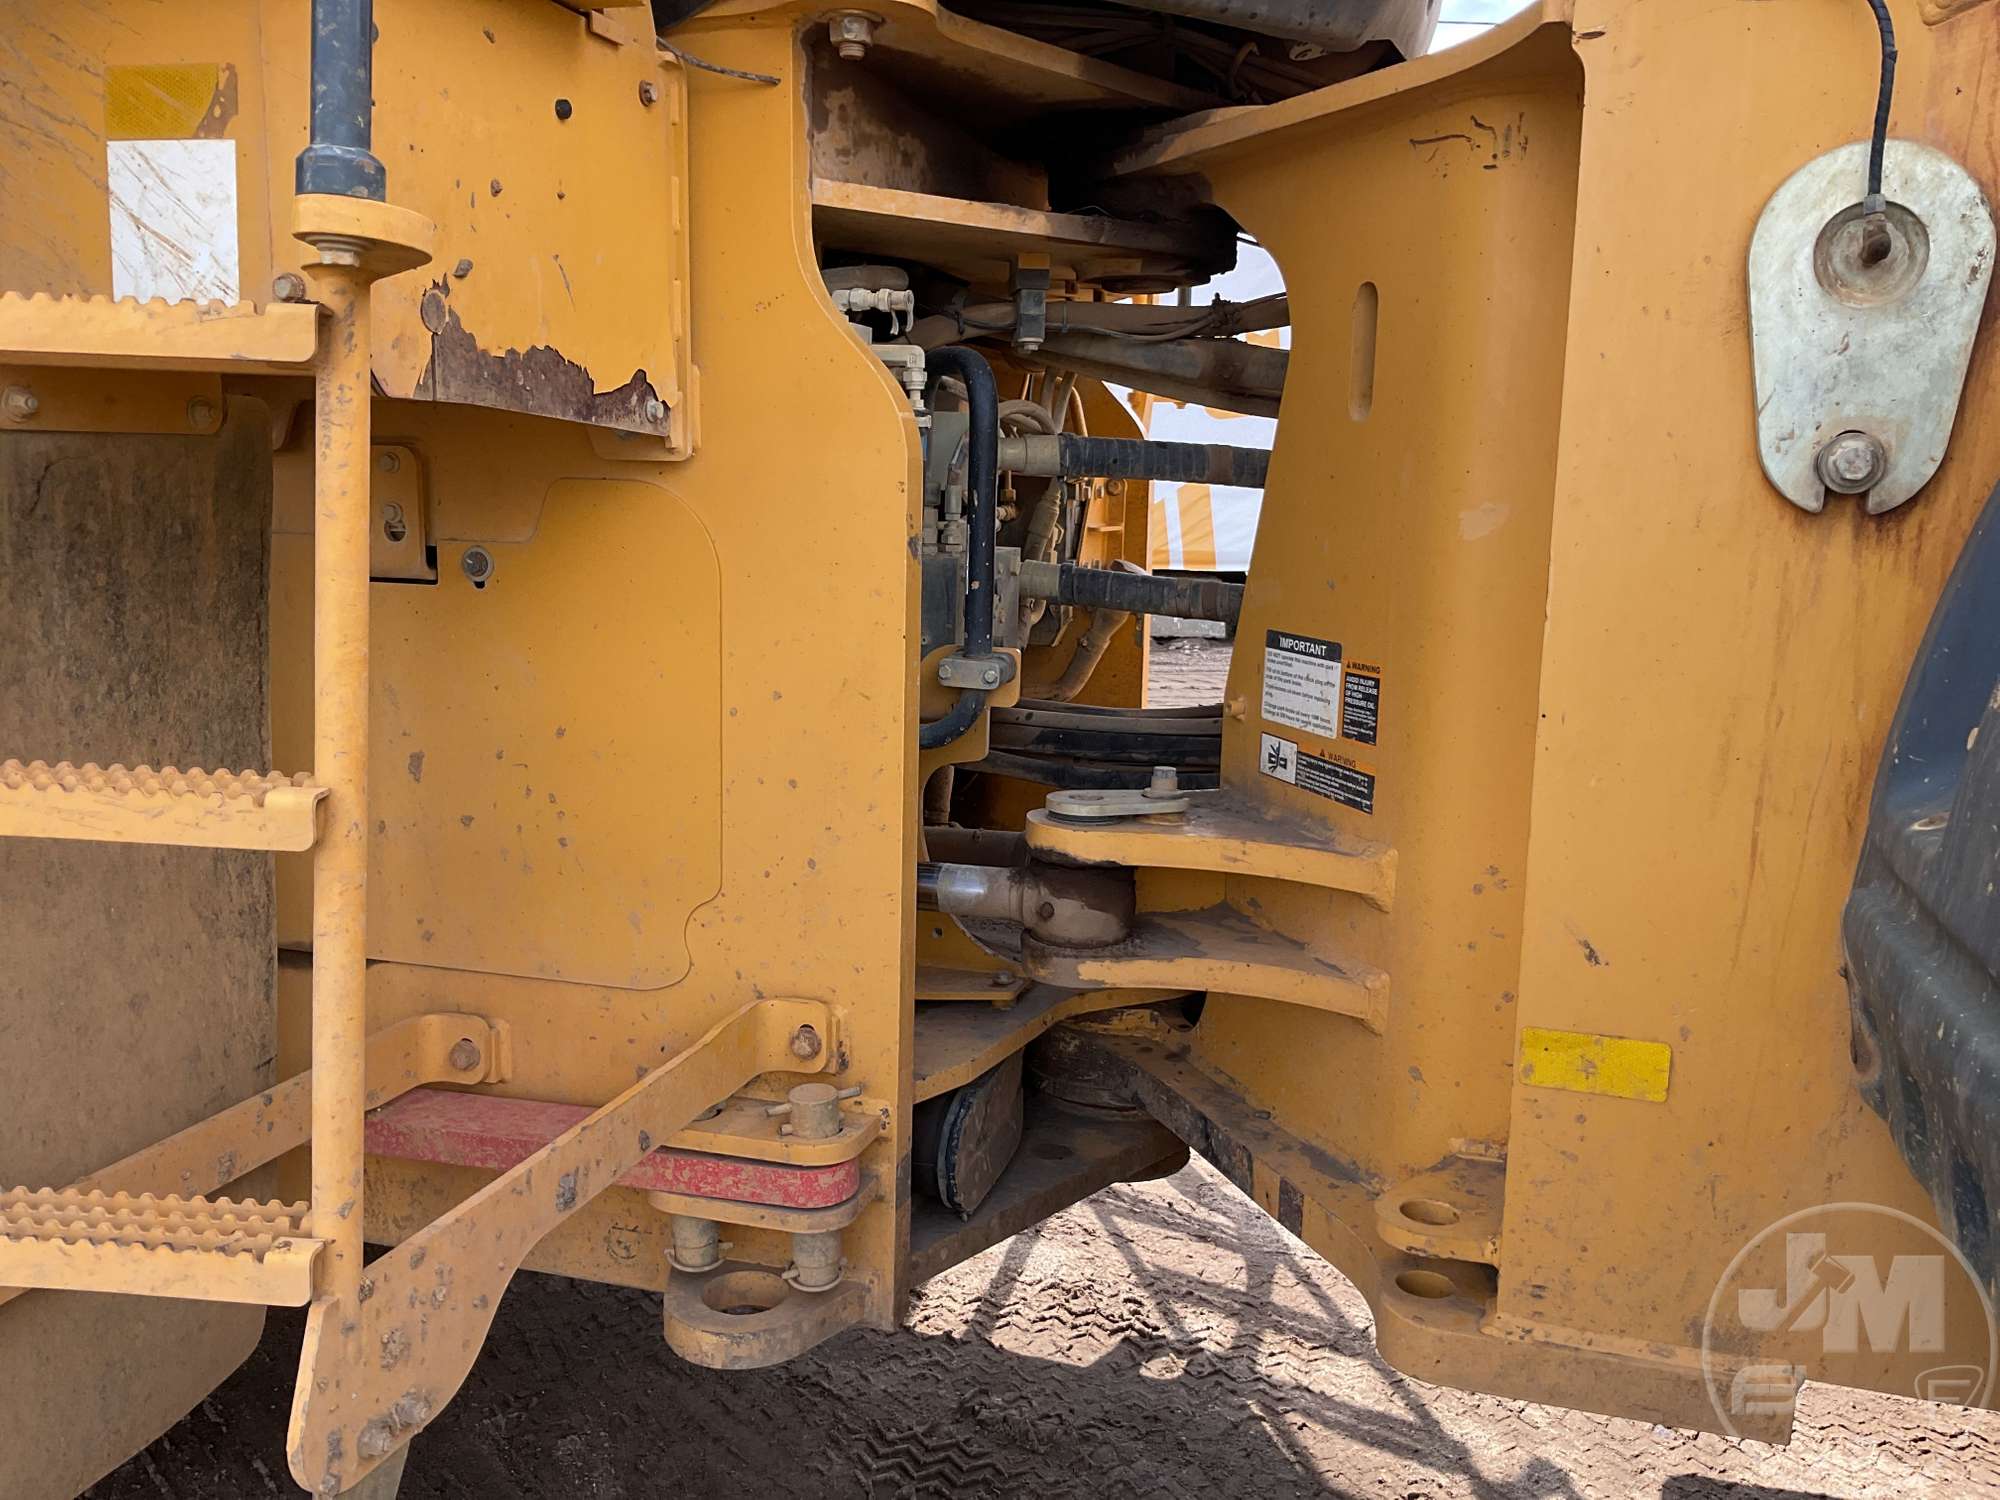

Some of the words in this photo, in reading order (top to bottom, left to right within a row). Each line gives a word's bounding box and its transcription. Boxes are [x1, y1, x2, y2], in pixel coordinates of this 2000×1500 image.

[1279, 636, 1327, 656] IMPORTANT
[1351, 662, 1381, 674] WARNING
[1328, 750, 1357, 768] WARNING
